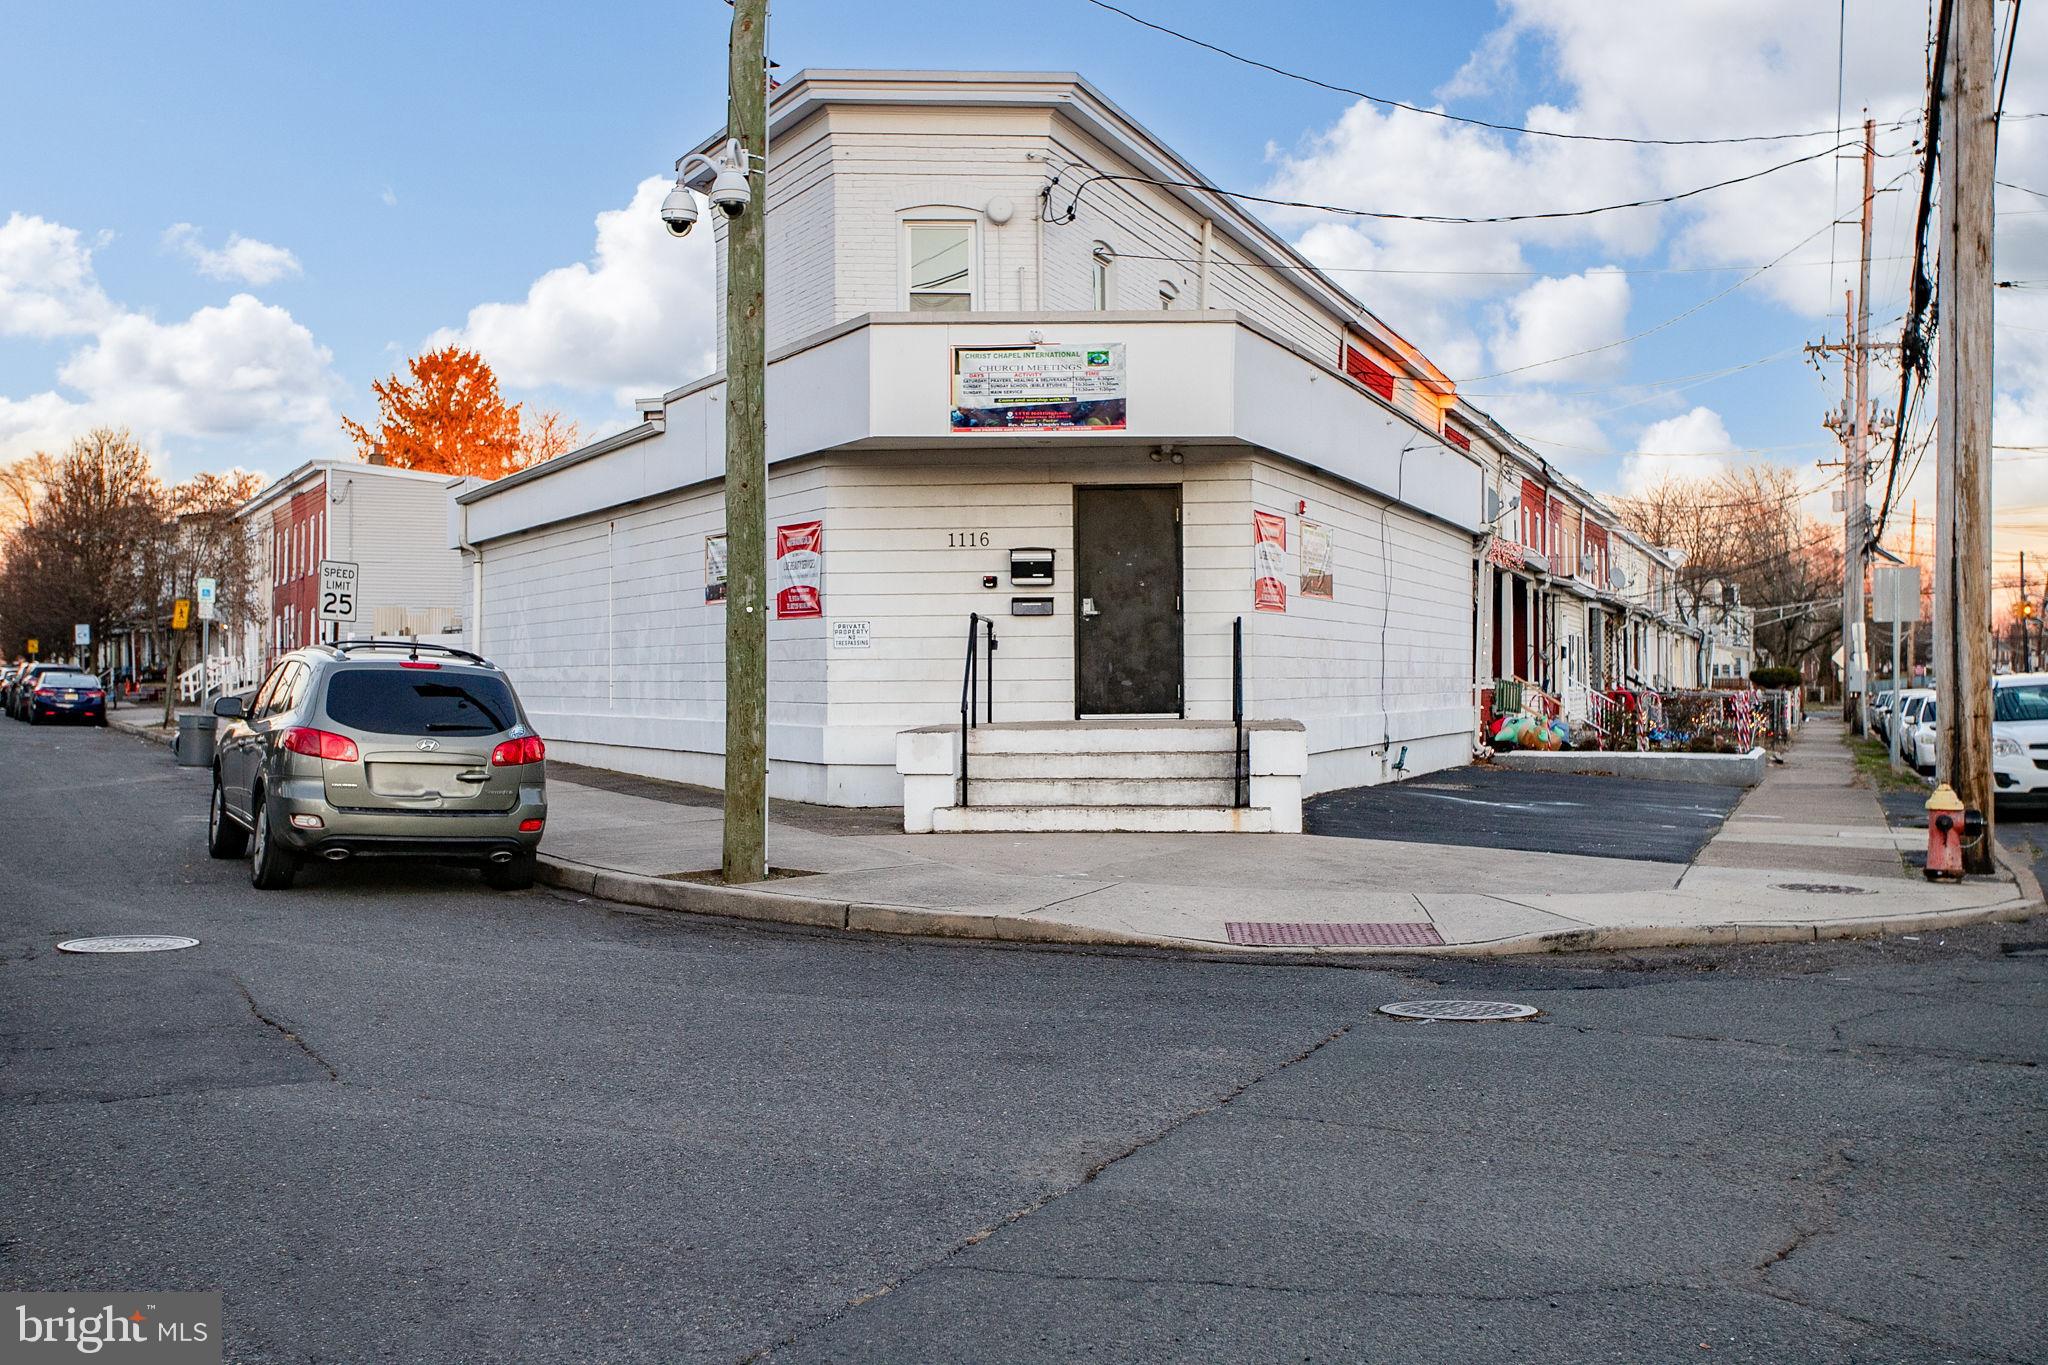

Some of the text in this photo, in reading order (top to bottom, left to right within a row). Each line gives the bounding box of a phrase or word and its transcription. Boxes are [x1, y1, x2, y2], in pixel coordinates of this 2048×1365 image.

[948, 532, 990, 548] 1116
[324, 567, 355, 579] SPEED
[326, 580, 351, 590] LIMIT
[324, 592, 352, 615] 25
